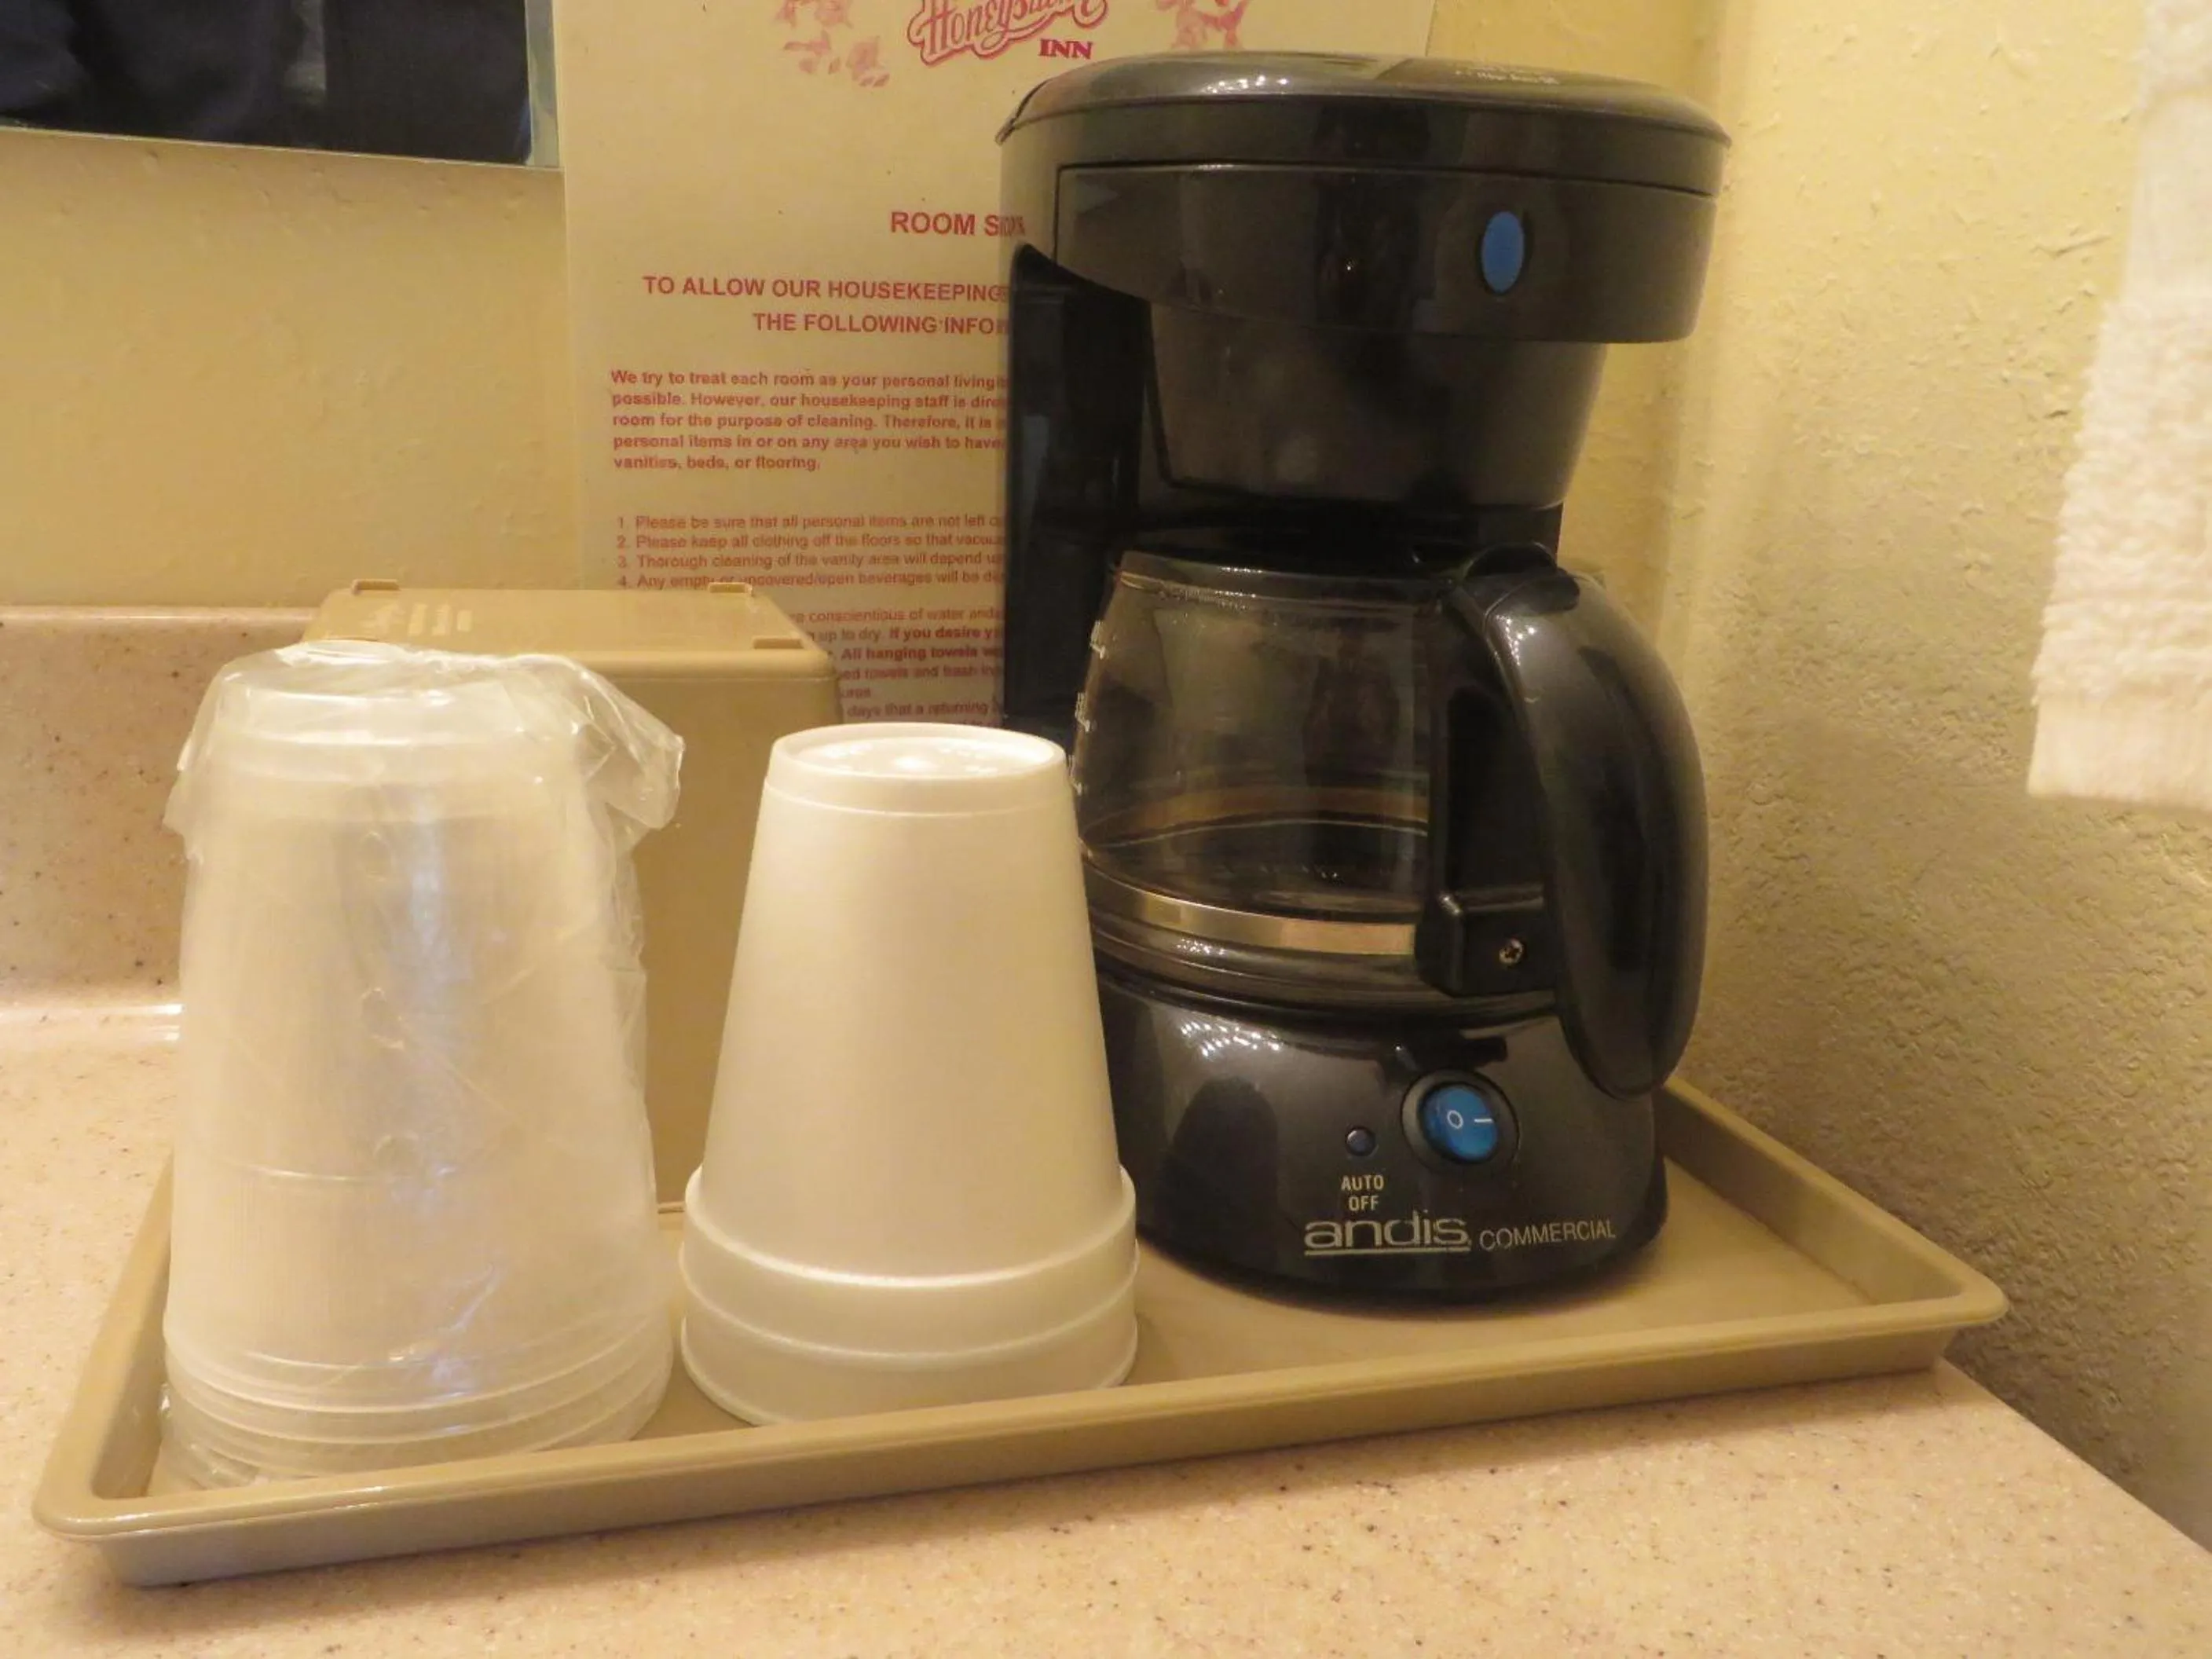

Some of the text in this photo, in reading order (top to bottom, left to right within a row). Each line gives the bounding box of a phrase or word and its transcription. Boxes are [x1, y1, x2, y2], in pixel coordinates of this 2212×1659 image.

[1038, 38, 1093, 59] INN
[891, 211, 976, 235] ROOM
[643, 276, 1002, 302] TO ALLOW OUR HOUSEKEEPING
[753, 313, 797, 331] THE
[804, 313, 937, 334] FOLLOWING
[611, 370, 994, 390] We try to treat each room as your personal living
[612, 393, 685, 408] possible.
[770, 395, 797, 406] our
[801, 394, 910, 409] housekeeping
[915, 394, 948, 408] staff
[954, 395, 965, 408] is
[613, 413, 991, 430] room for the purpose of cleaning. Therefore, it is
[613, 435, 683, 450] personal
[690, 435, 731, 448] items
[737, 435, 751, 448] in
[756, 437, 771, 448] or
[777, 437, 797, 448] on
[802, 438, 829, 451] any
[834, 438, 868, 449] area
[873, 438, 901, 451] you
[906, 436, 940, 449] wish
[945, 436, 960, 449] to
[734, 457, 752, 469] or
[635, 516, 687, 529] Please
[691, 516, 709, 529] be
[714, 518, 745, 530] sure
[750, 515, 777, 529] that
[782, 515, 798, 529] all
[803, 515, 865, 530] personal
[870, 515, 904, 528] items
[910, 517, 934, 528] are
[939, 516, 960, 528] not
[965, 515, 985, 528] left
[636, 535, 687, 548] Please
[691, 535, 727, 551] keep
[732, 535, 749, 548] all
[753, 534, 808, 550] clothing
[812, 533, 830, 548] off
[836, 533, 857, 547] the
[862, 533, 901, 547] floors
[905, 535, 921, 546] so
[926, 533, 953, 546] that
[637, 555, 707, 570] Thorough
[712, 555, 772, 570] cleaning
[777, 554, 791, 566] of
[795, 553, 817, 566] the
[822, 553, 863, 568] vanity
[869, 555, 899, 566] area
[904, 552, 925, 565] will
[930, 551, 981, 567] depend
[637, 575, 665, 591] Any
[859, 571, 932, 587] beverages
[936, 570, 958, 584] will
[962, 570, 980, 584] be
[809, 610, 904, 624] conscientious
[909, 608, 922, 621] of
[927, 609, 965, 621] water
[841, 628, 857, 641] to
[889, 626, 899, 639] If
[903, 628, 932, 642] you
[936, 625, 980, 639] desire
[840, 648, 862, 661] All
[866, 647, 927, 662] hanging
[931, 645, 978, 658] towels
[1340, 1174, 1384, 1192] AUTO
[1348, 1195, 1379, 1212] OFF
[1304, 1209, 1617, 1252] andis COMMERCIAL
